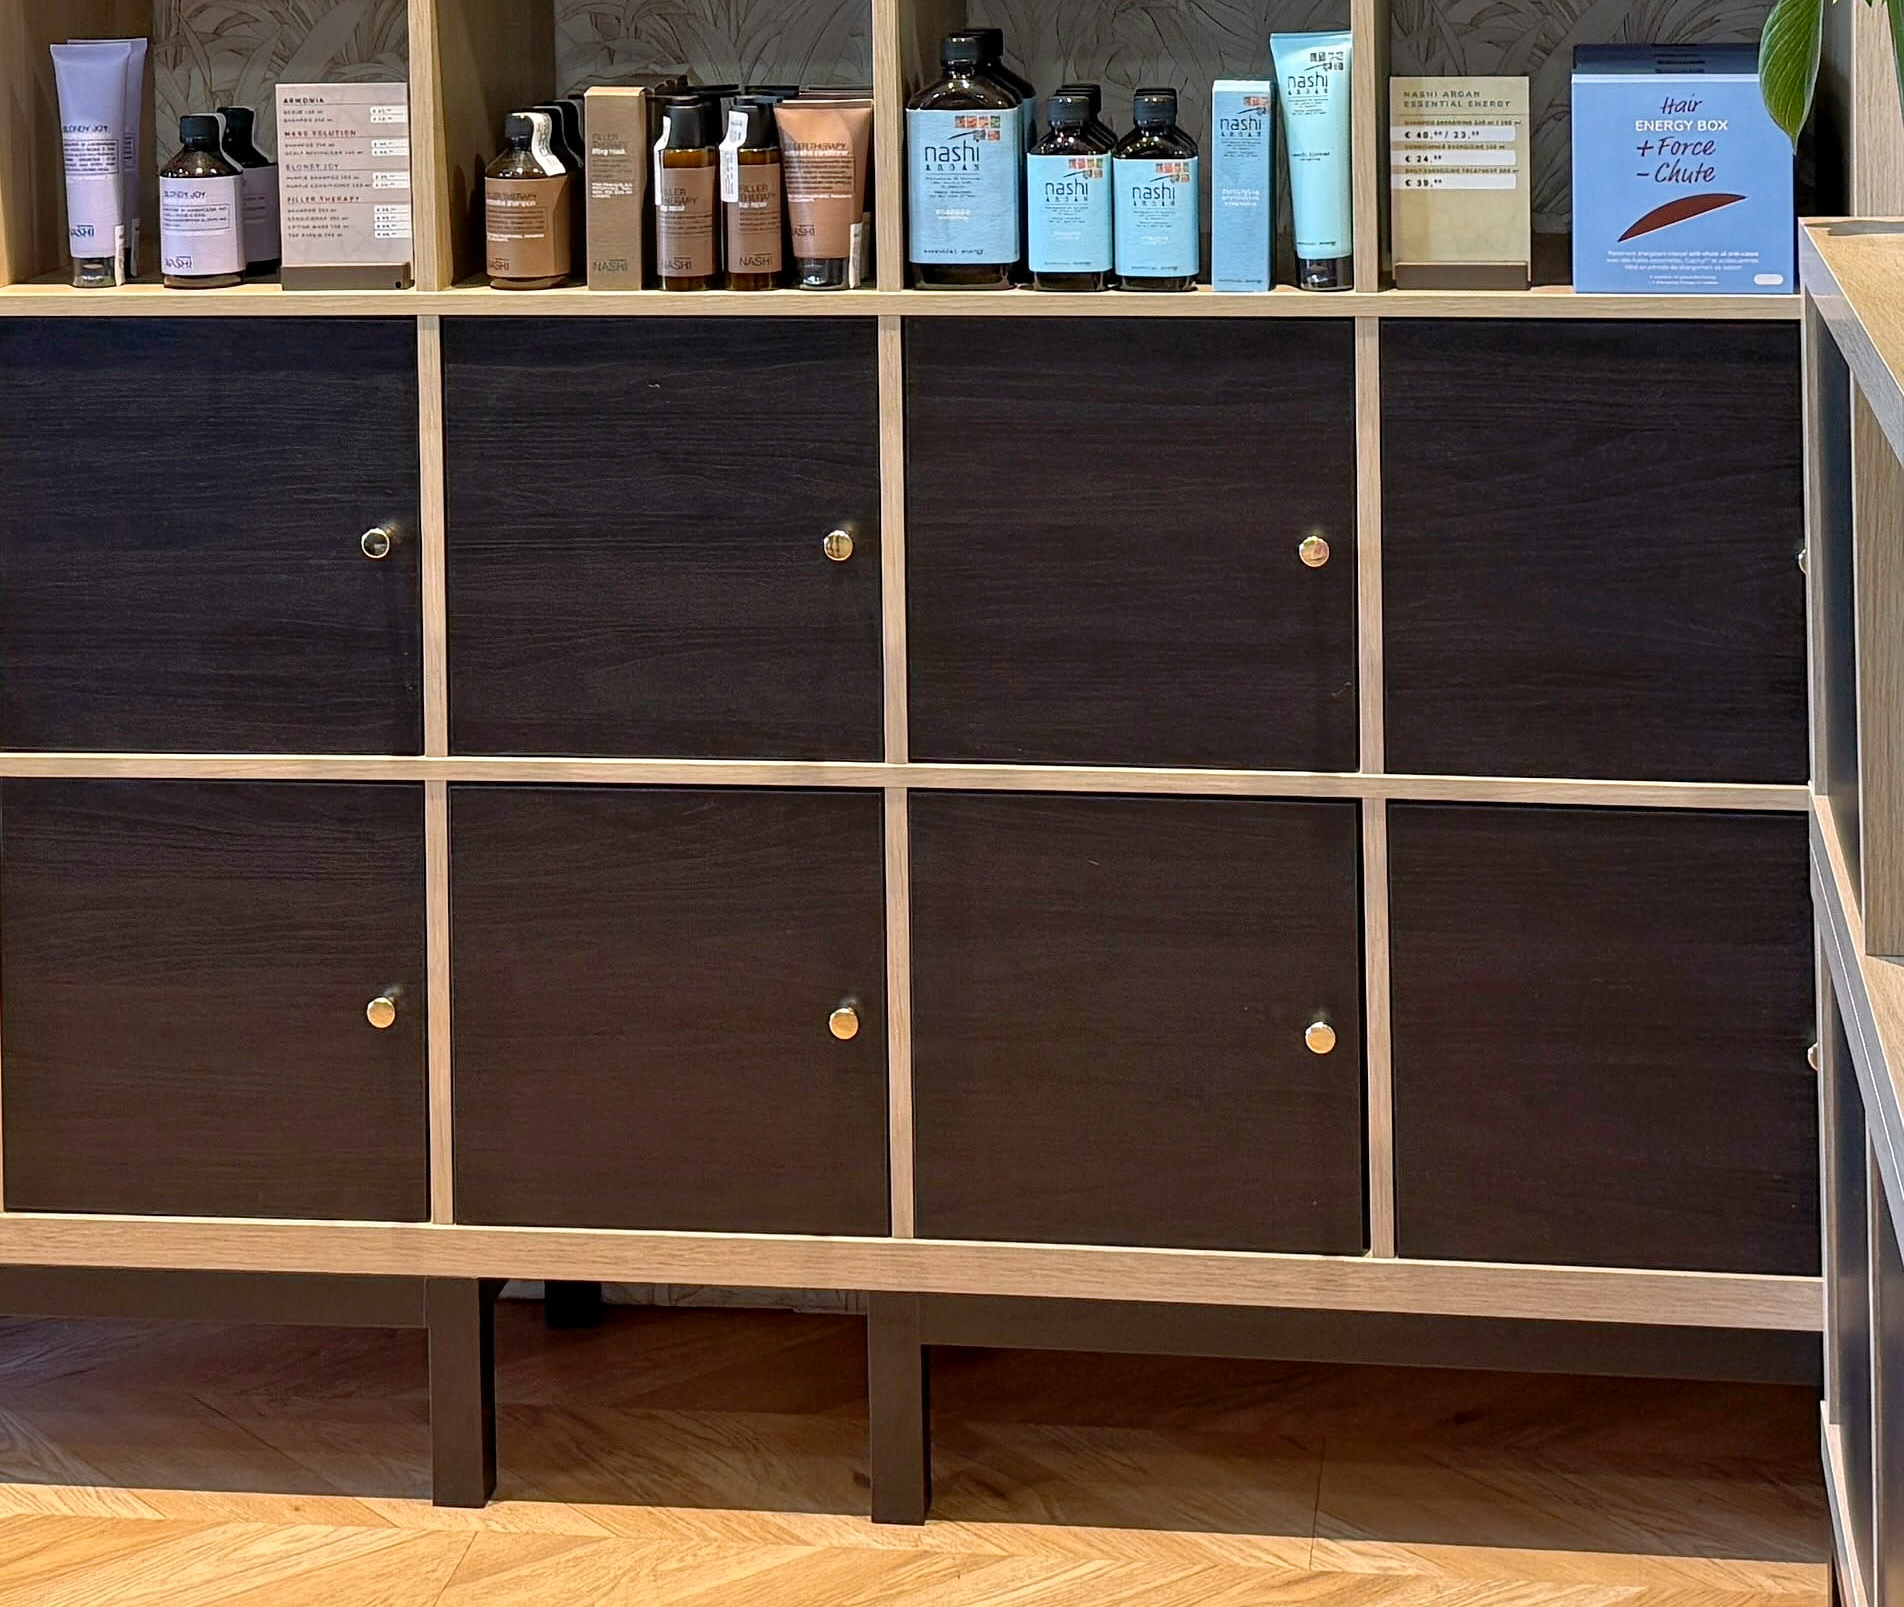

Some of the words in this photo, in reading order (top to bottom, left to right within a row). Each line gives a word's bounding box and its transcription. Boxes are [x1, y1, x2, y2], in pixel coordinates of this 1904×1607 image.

[1287, 72, 1329, 89] nashi
[1403, 99, 1463, 108] ESSENTIAL
[1467, 99, 1511, 108] ENERGY
[1659, 92, 1703, 115] Hair
[1220, 115, 1263, 132] nashi
[1635, 119, 1694, 132] ENERGY
[1697, 119, 1729, 131] BOX
[924, 138, 980, 162] nashi
[1657, 136, 1716, 157] Force
[1654, 158, 1717, 184] Chute
[1045, 177, 1089, 196] nashi
[1132, 180, 1176, 200] nashi
